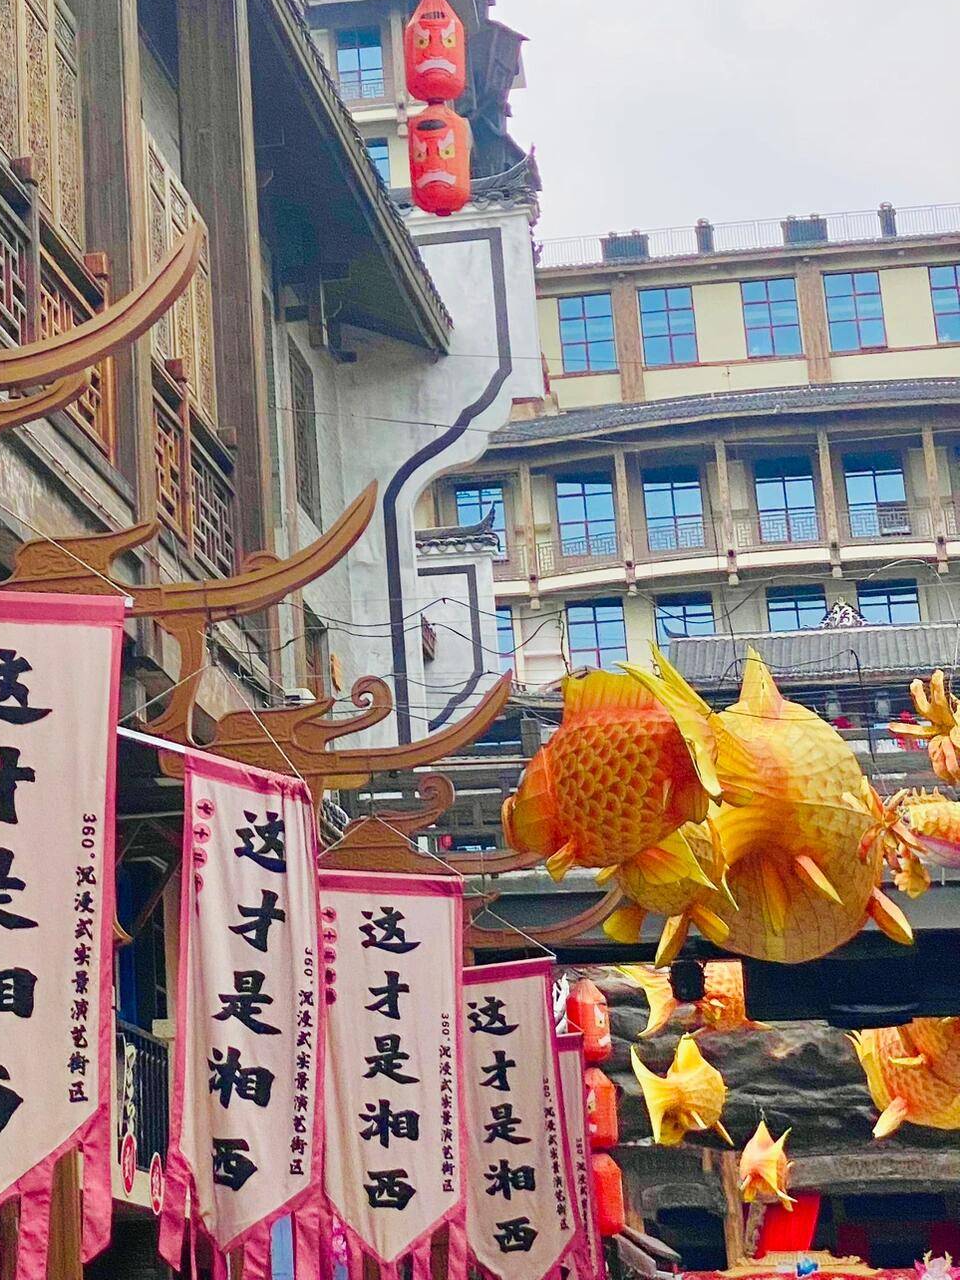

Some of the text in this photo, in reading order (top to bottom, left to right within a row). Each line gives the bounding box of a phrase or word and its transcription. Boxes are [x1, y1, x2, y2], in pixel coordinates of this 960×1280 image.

[67, 813, 98, 1103] 360°沉浸式实景演艺街区
[207, 810, 287, 1192] 这才是湘西
[358, 906, 422, 1211] 这才是湘西
[466, 996, 539, 1253] 这才是湘西
